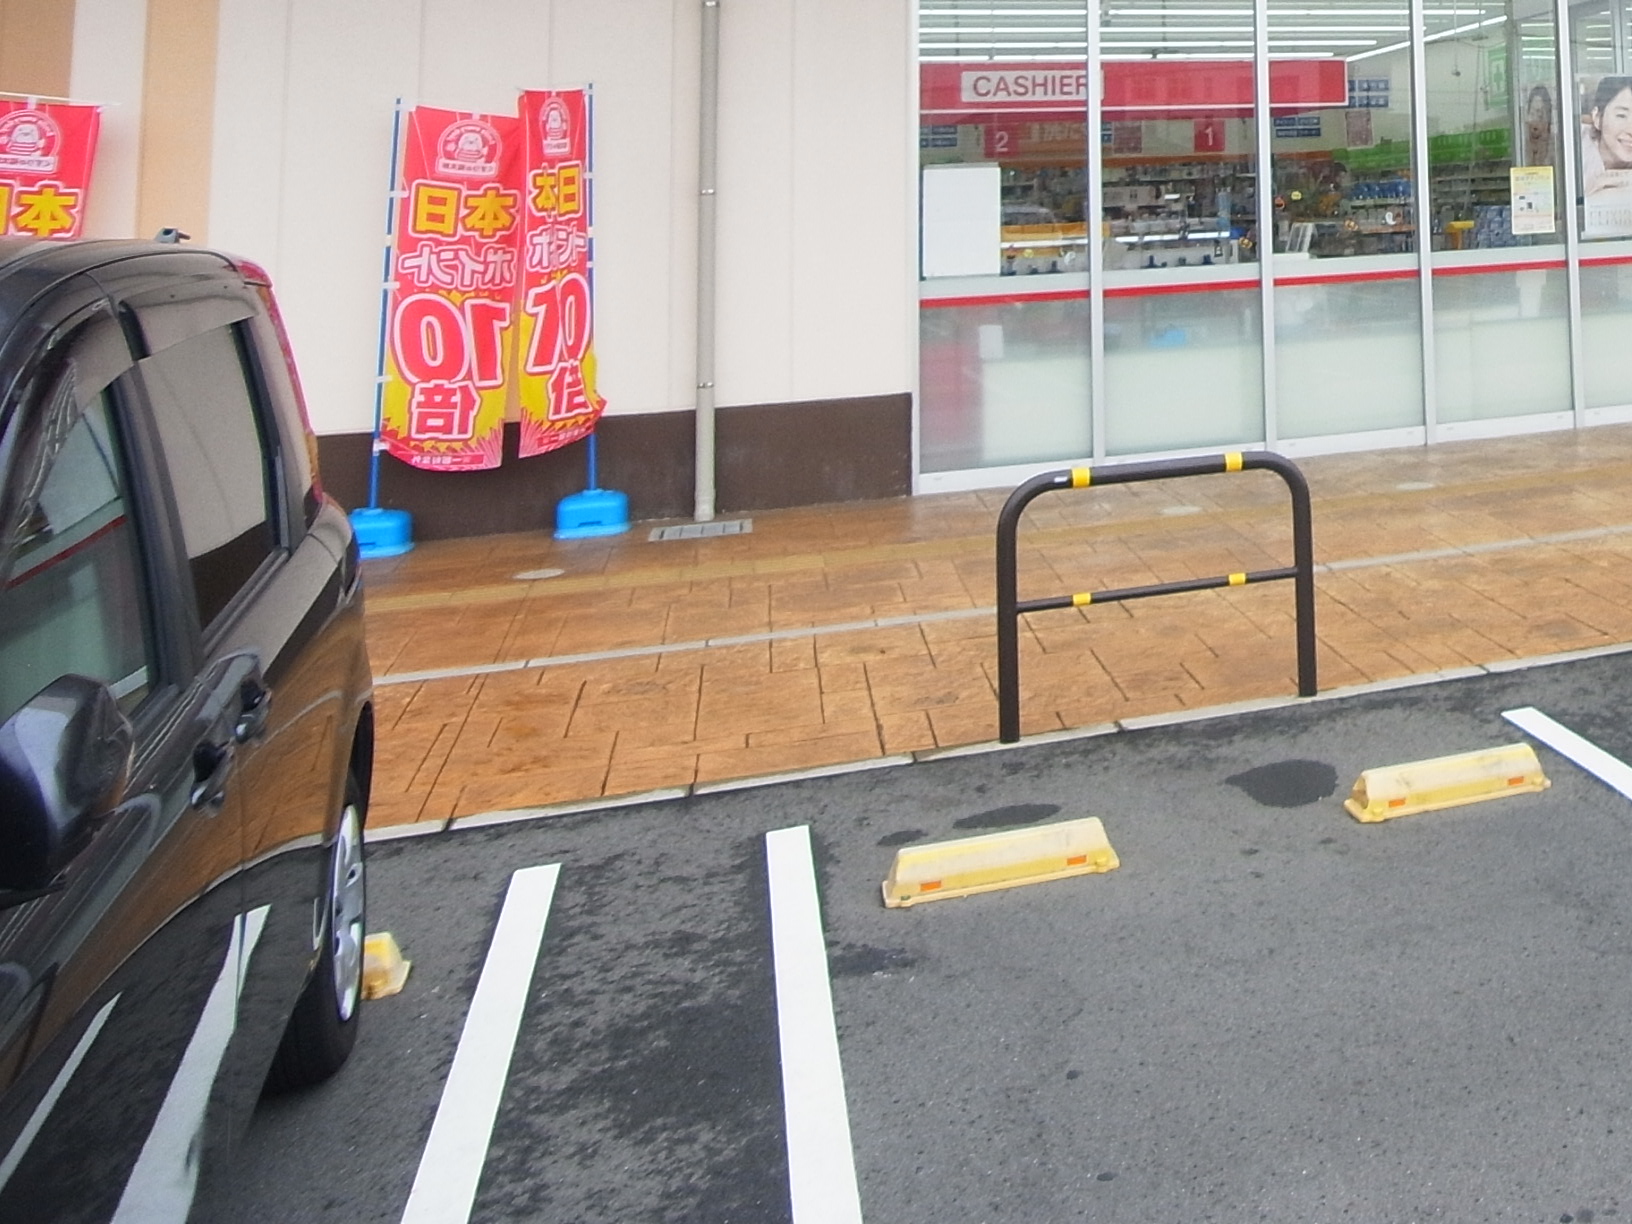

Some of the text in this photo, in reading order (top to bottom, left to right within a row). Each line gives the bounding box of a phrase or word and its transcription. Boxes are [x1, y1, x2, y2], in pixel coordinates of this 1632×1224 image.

[995, 131, 1009, 152] 2
[1204, 126, 1214, 146] 1
[526, 276, 591, 373] 10
